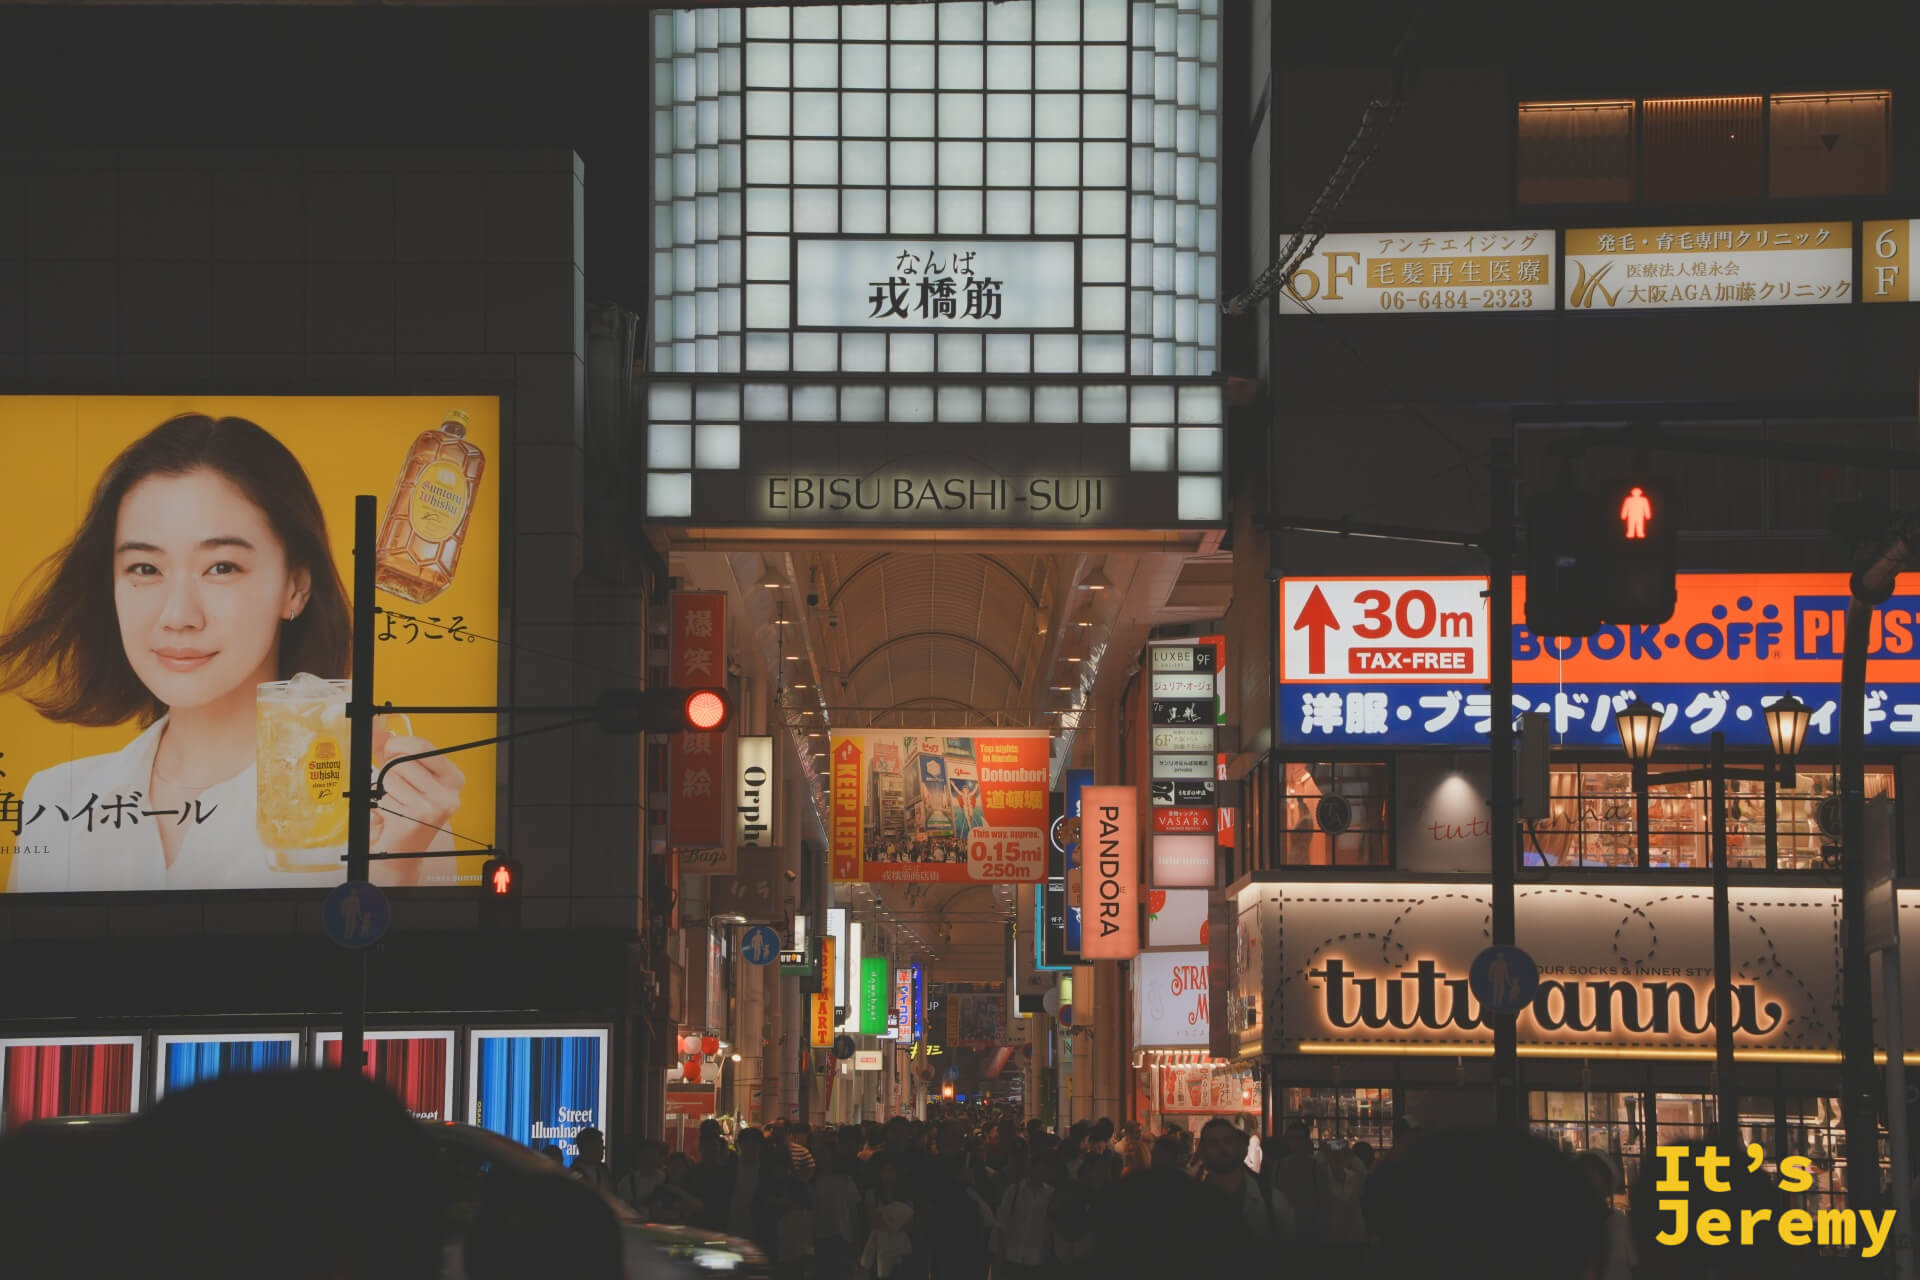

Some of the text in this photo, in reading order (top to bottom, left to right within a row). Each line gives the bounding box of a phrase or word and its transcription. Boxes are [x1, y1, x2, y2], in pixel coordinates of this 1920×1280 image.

[1378, 232, 1538, 254] アンチエイジング
[1599, 229, 1831, 252] 発毛・育毛専門クリニック
[896, 249, 976, 275] なんば
[1374, 260, 1542, 285] 毛髪再生医療
[868, 276, 1004, 320] 戎橋筋
[1379, 289, 1533, 310] 06-6484-2323
[1627, 280, 1851, 304] 大阪AGA加藤クリニック
[768, 477, 881, 510] EBISU
[1352, 589, 1473, 639] 30m
[377, 615, 476, 645] ようこそ。
[1154, 651, 1211, 666] LUXBE 9F
[1356, 652, 1466, 670] TAX-FREE
[682, 609, 713, 799] 爆笑顔絵
[1154, 734, 1173, 747] 6F
[980, 767, 1047, 784] Dotonbori
[835, 763, 857, 860] KEEP LEFT
[1159, 817, 1209, 826] VASARA
[971, 841, 1041, 862] 0.15mi
[981, 863, 1031, 878] 250m
[1099, 806, 1120, 938] PANDORA
[1569, 966, 1618, 976] SOCKS
[1622, 967, 1631, 976] &
[1635, 967, 1681, 977] INNER
[1686, 968, 1713, 977] STY
[558, 1106, 593, 1123] Street
[531, 1121, 595, 1139] Illuminat
